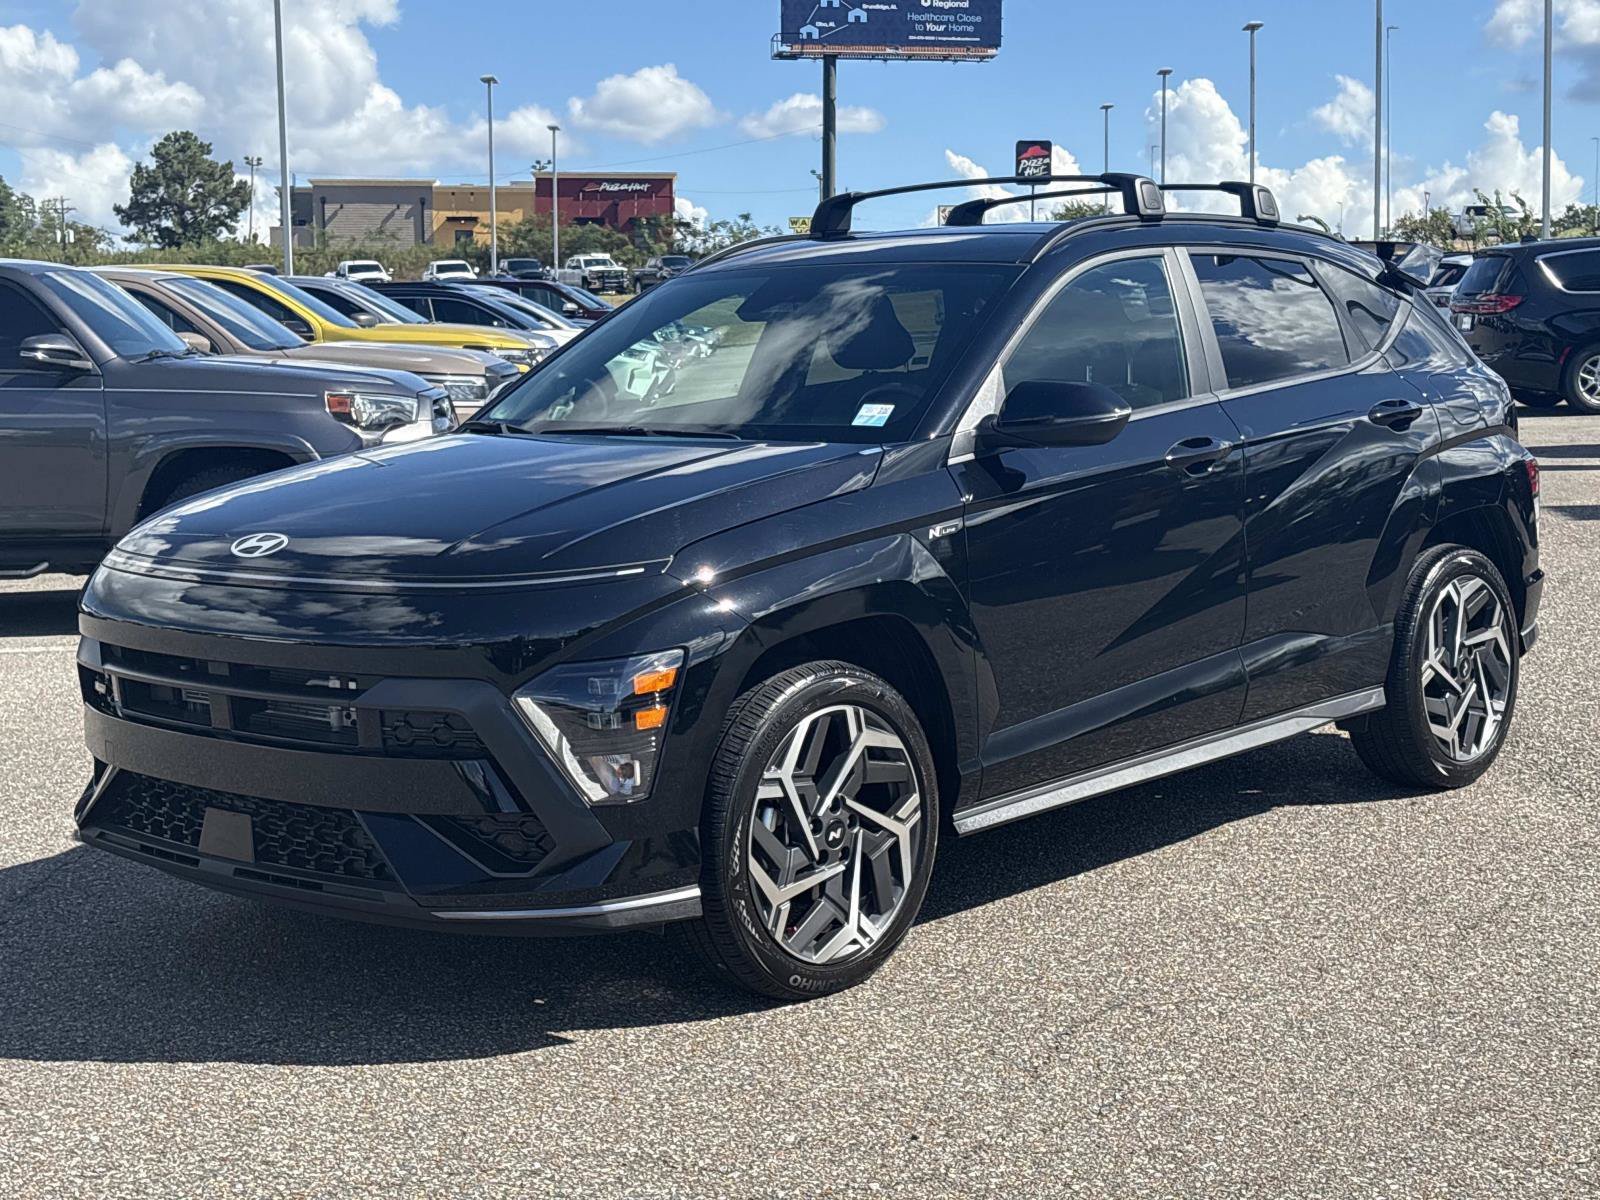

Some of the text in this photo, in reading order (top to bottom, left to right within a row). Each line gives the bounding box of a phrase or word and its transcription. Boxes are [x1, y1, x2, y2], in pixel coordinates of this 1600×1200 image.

[933, 0, 969, 9] Regional
[907, 12, 982, 22] Healthcare Close
[915, 23, 975, 32] to Your Home
[1018, 157, 1050, 174] Pizza
[1024, 165, 1048, 177] Hut
